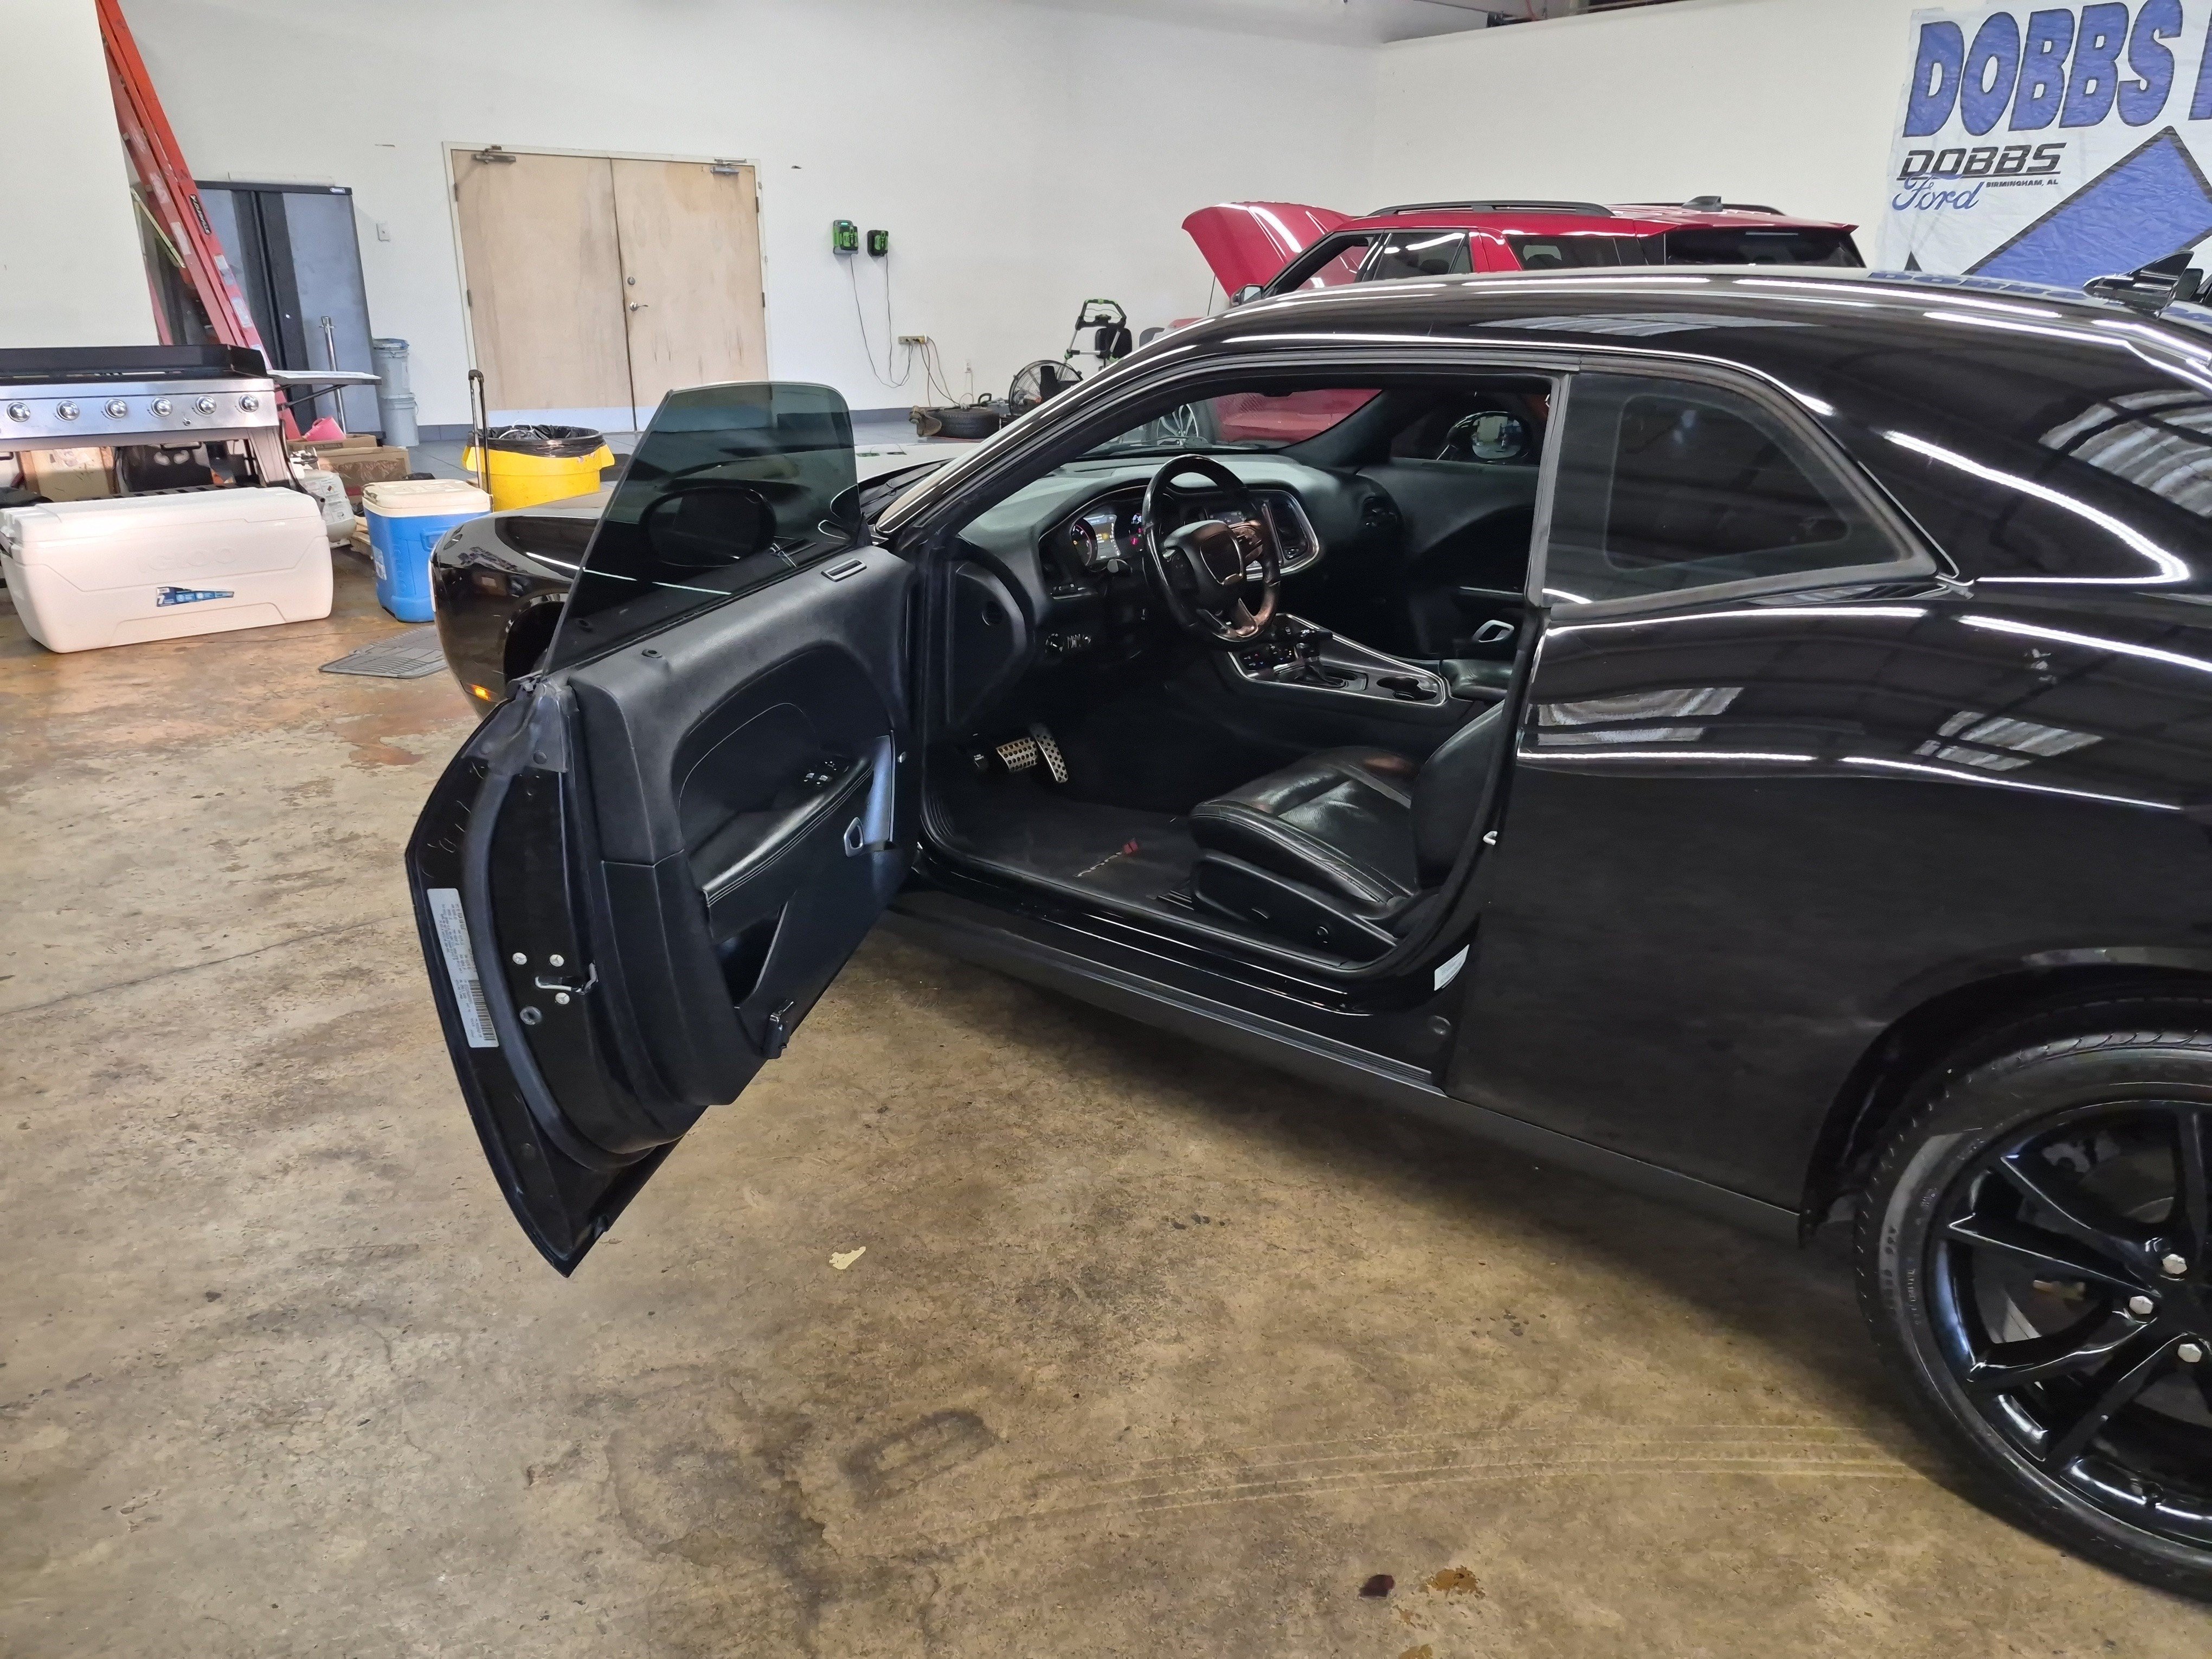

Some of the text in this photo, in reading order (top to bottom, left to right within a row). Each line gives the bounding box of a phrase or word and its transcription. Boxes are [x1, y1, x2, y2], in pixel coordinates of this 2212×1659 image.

[1902, 0, 2183, 137] DOBBS
[1899, 143, 2067, 177] DOBBS
[1892, 172, 1985, 210] Ford
